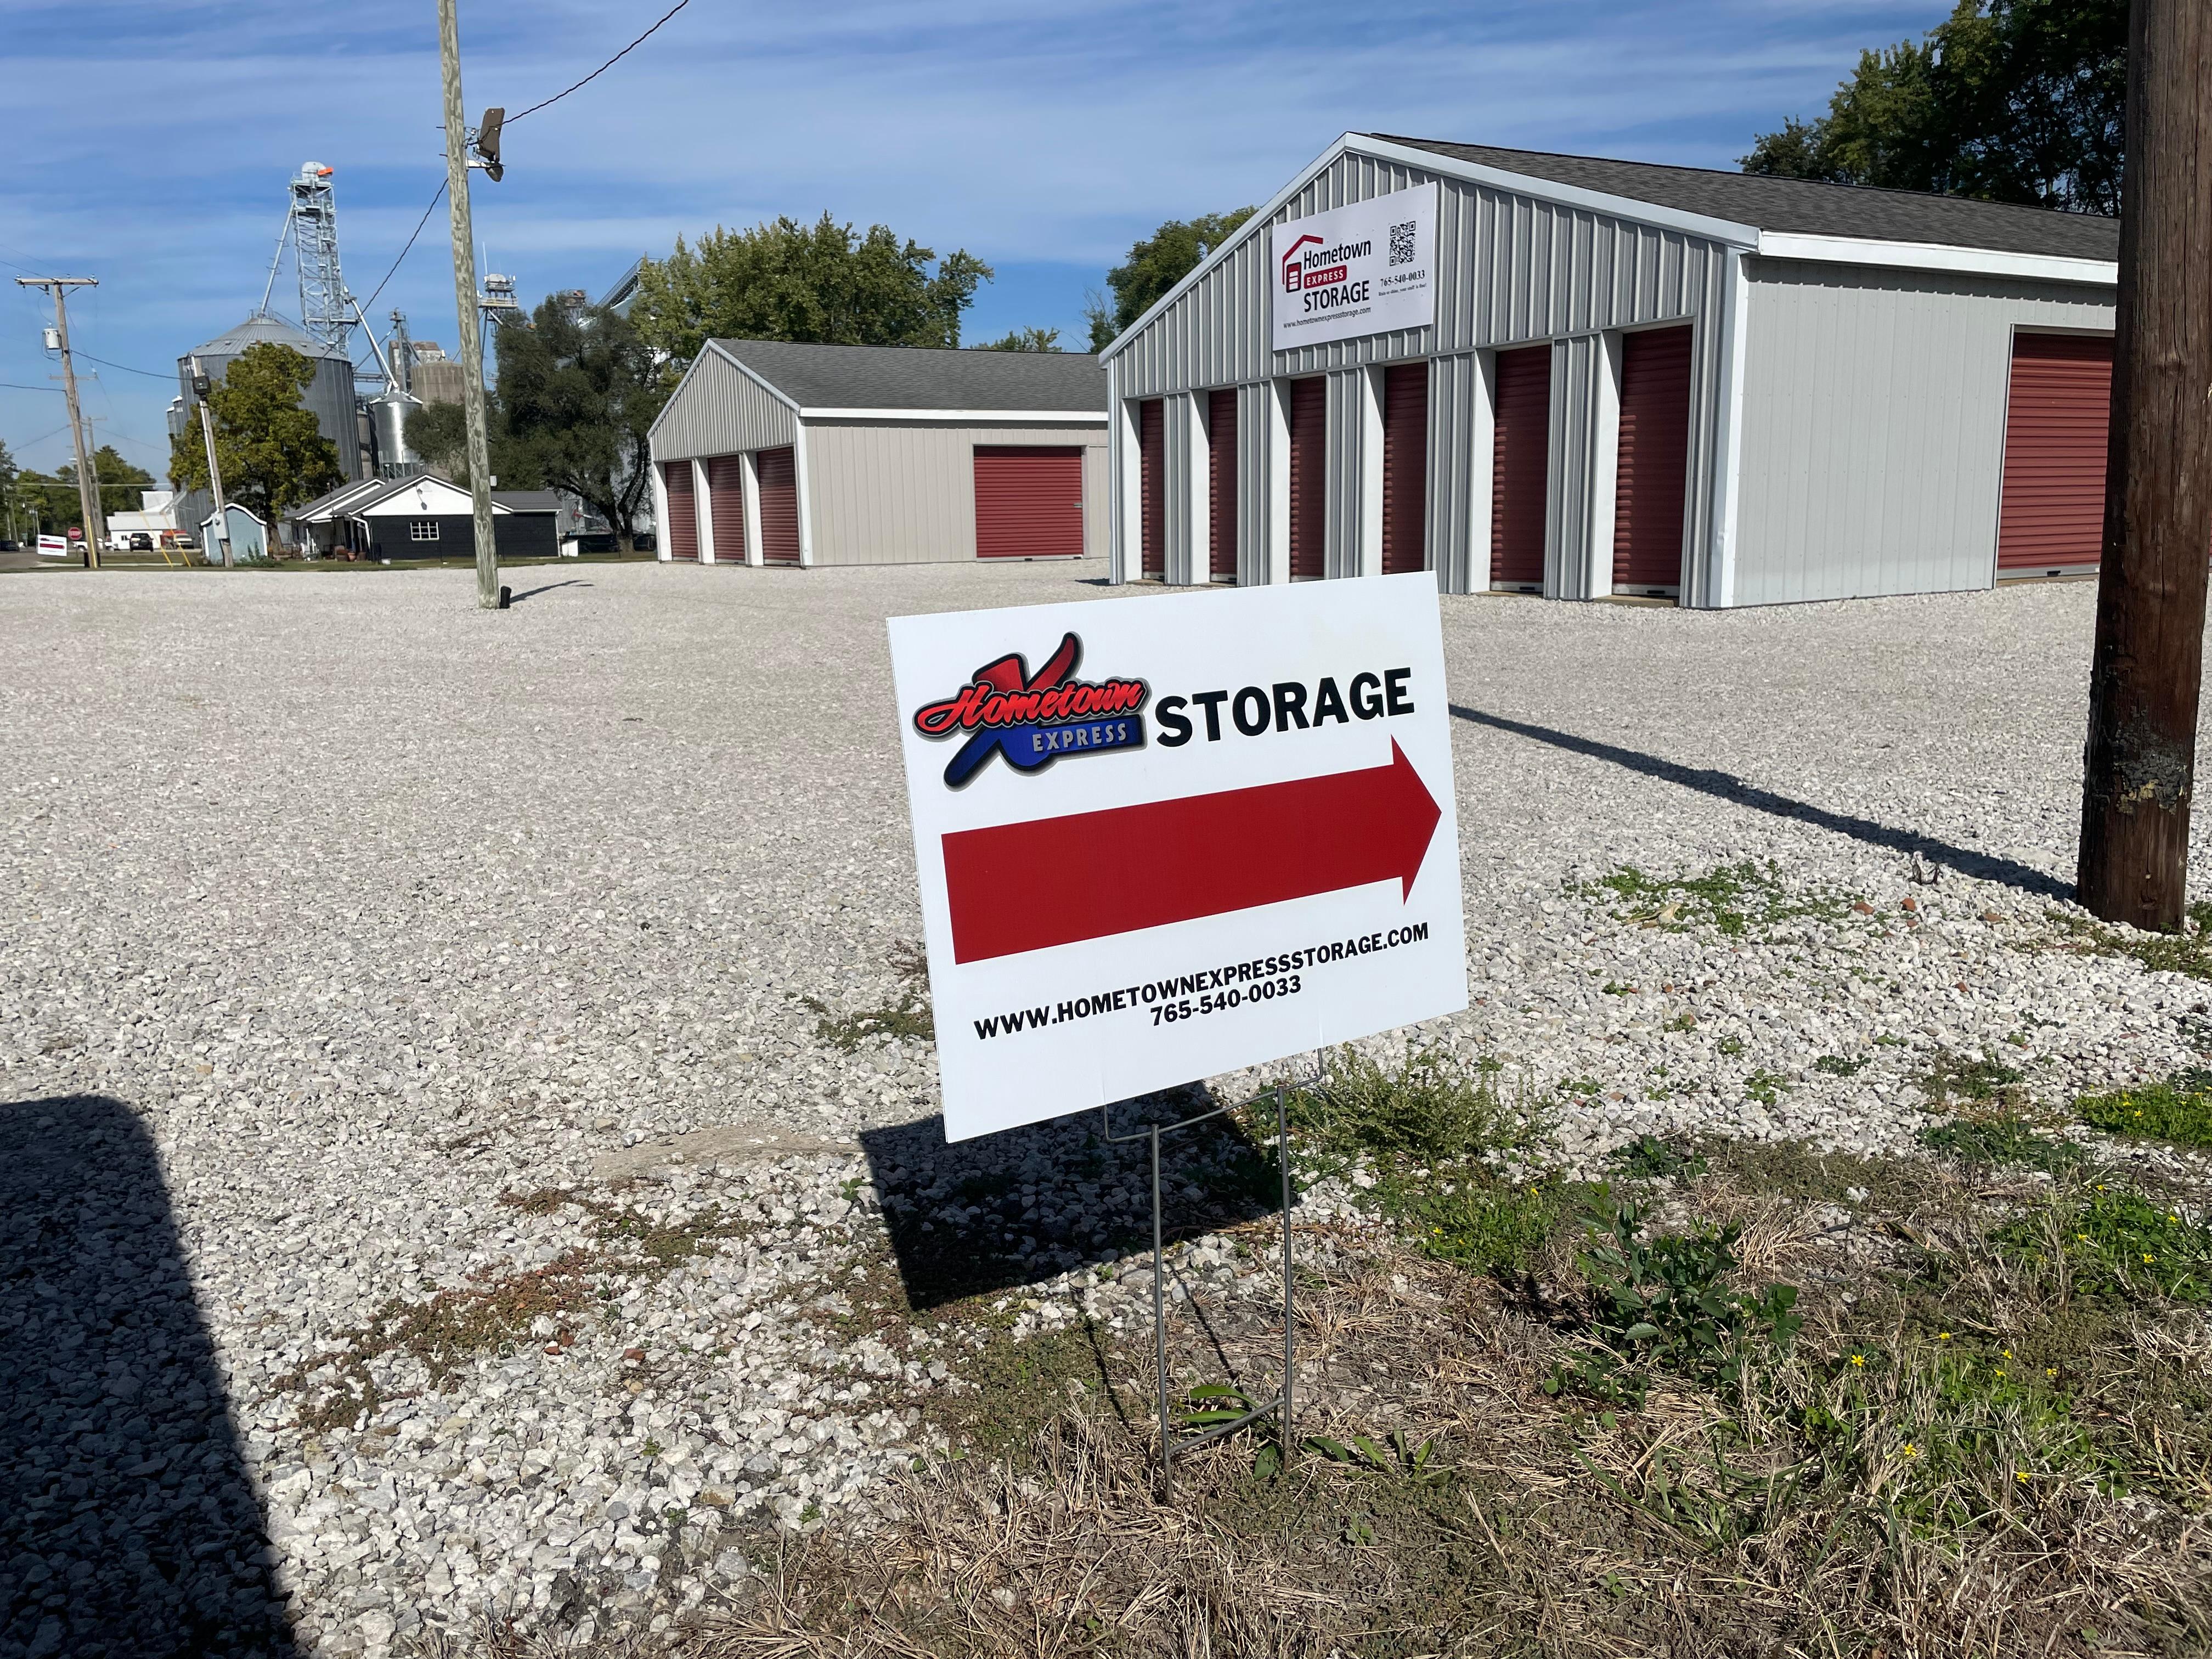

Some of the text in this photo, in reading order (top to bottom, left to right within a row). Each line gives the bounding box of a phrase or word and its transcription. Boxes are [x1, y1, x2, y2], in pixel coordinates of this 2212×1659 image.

[1304, 239, 1371, 270] Hometown
[1306, 269, 1344, 286] EXPRESS
[1380, 269, 1425, 287] 765-540-0033
[1304, 280, 1370, 313] STORAGE
[915, 679, 1146, 735] Hometown
[1155, 667, 1415, 747] STORAGE
[1032, 723, 1128, 752] EXPRESS
[973, 922, 1429, 1040] WWW.HOMETOWNEXPRESSSTORAGE.COM
[1150, 975, 1301, 1026] 765-540-0033
